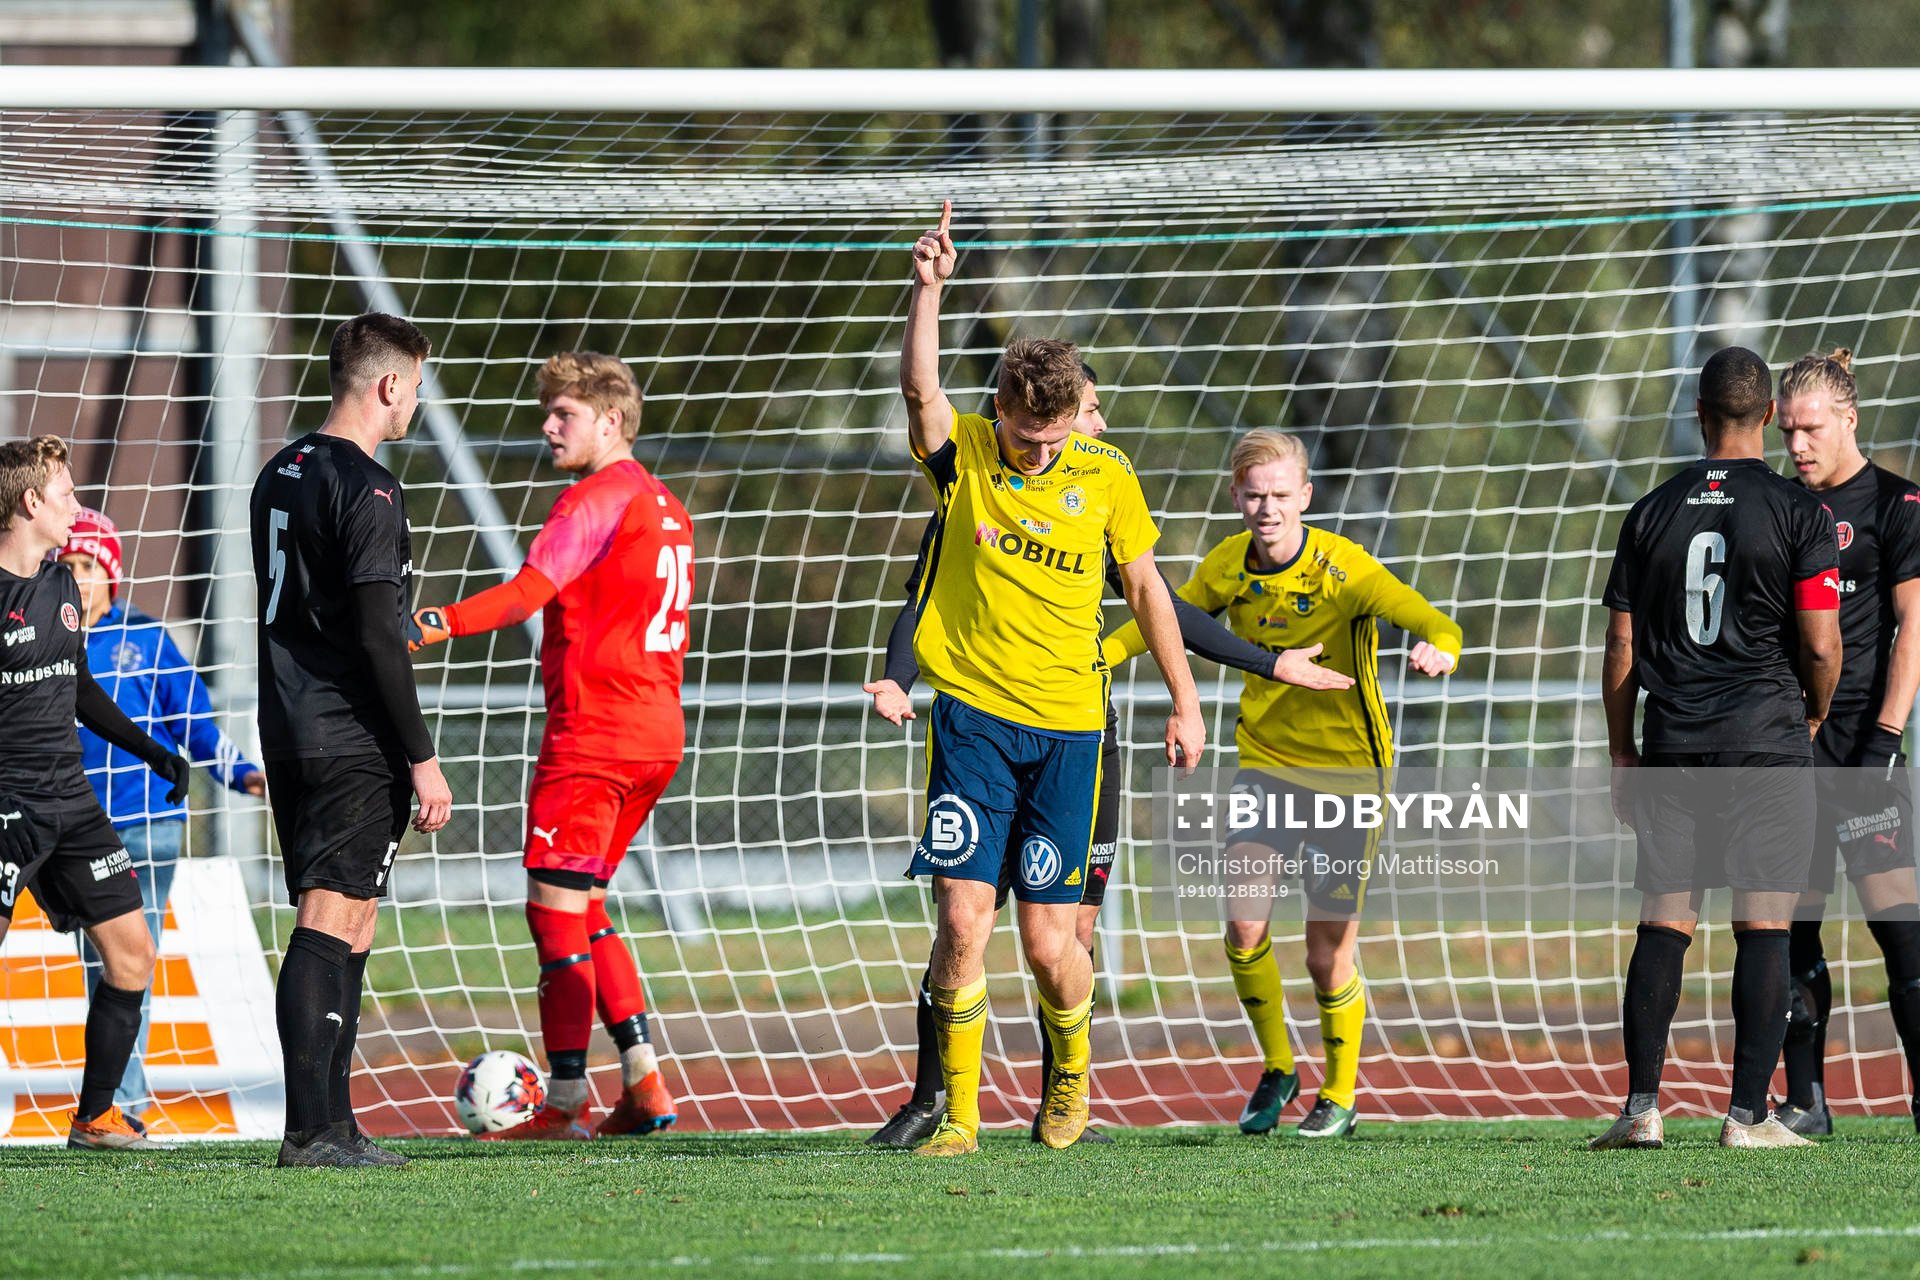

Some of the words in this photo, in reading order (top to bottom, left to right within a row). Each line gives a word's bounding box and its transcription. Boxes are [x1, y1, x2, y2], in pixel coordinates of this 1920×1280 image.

[1026, 478, 1054, 486] Resurs
[1700, 490, 1725, 498] NORRA
[1706, 470, 1729, 480] HIK
[264, 507, 289, 625] 5
[974, 521, 1085, 575] MOBILL
[645, 545, 693, 652] 25
[1685, 531, 1726, 646] 6
[375, 841, 399, 888] 5
[930, 843, 977, 868] BYGGMASKINER
